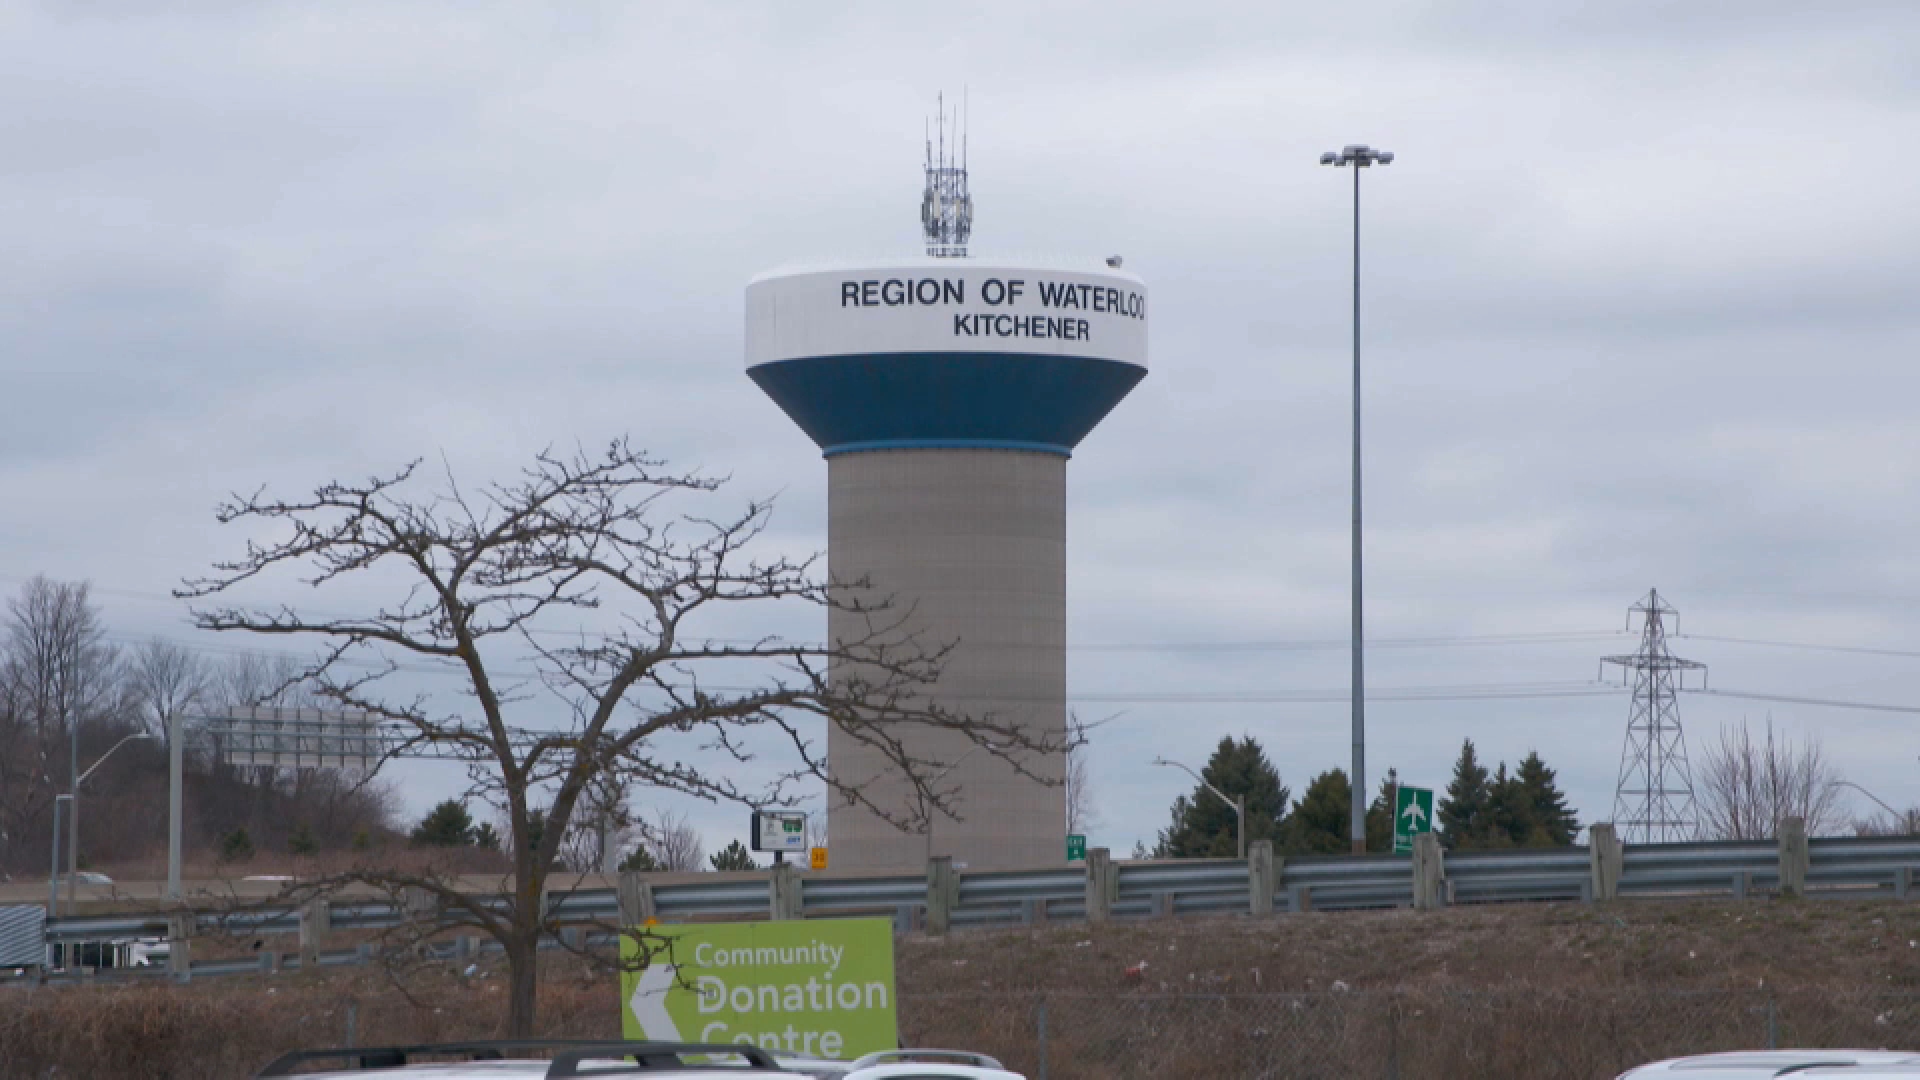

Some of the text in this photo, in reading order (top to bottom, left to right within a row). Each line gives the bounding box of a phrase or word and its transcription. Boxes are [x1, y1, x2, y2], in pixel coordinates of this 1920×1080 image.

[841, 278, 1145, 320] REGION OF WATERLOO
[954, 314, 1090, 341] KITCHENER
[695, 939, 844, 971] Community
[696, 972, 887, 1014] Donation
